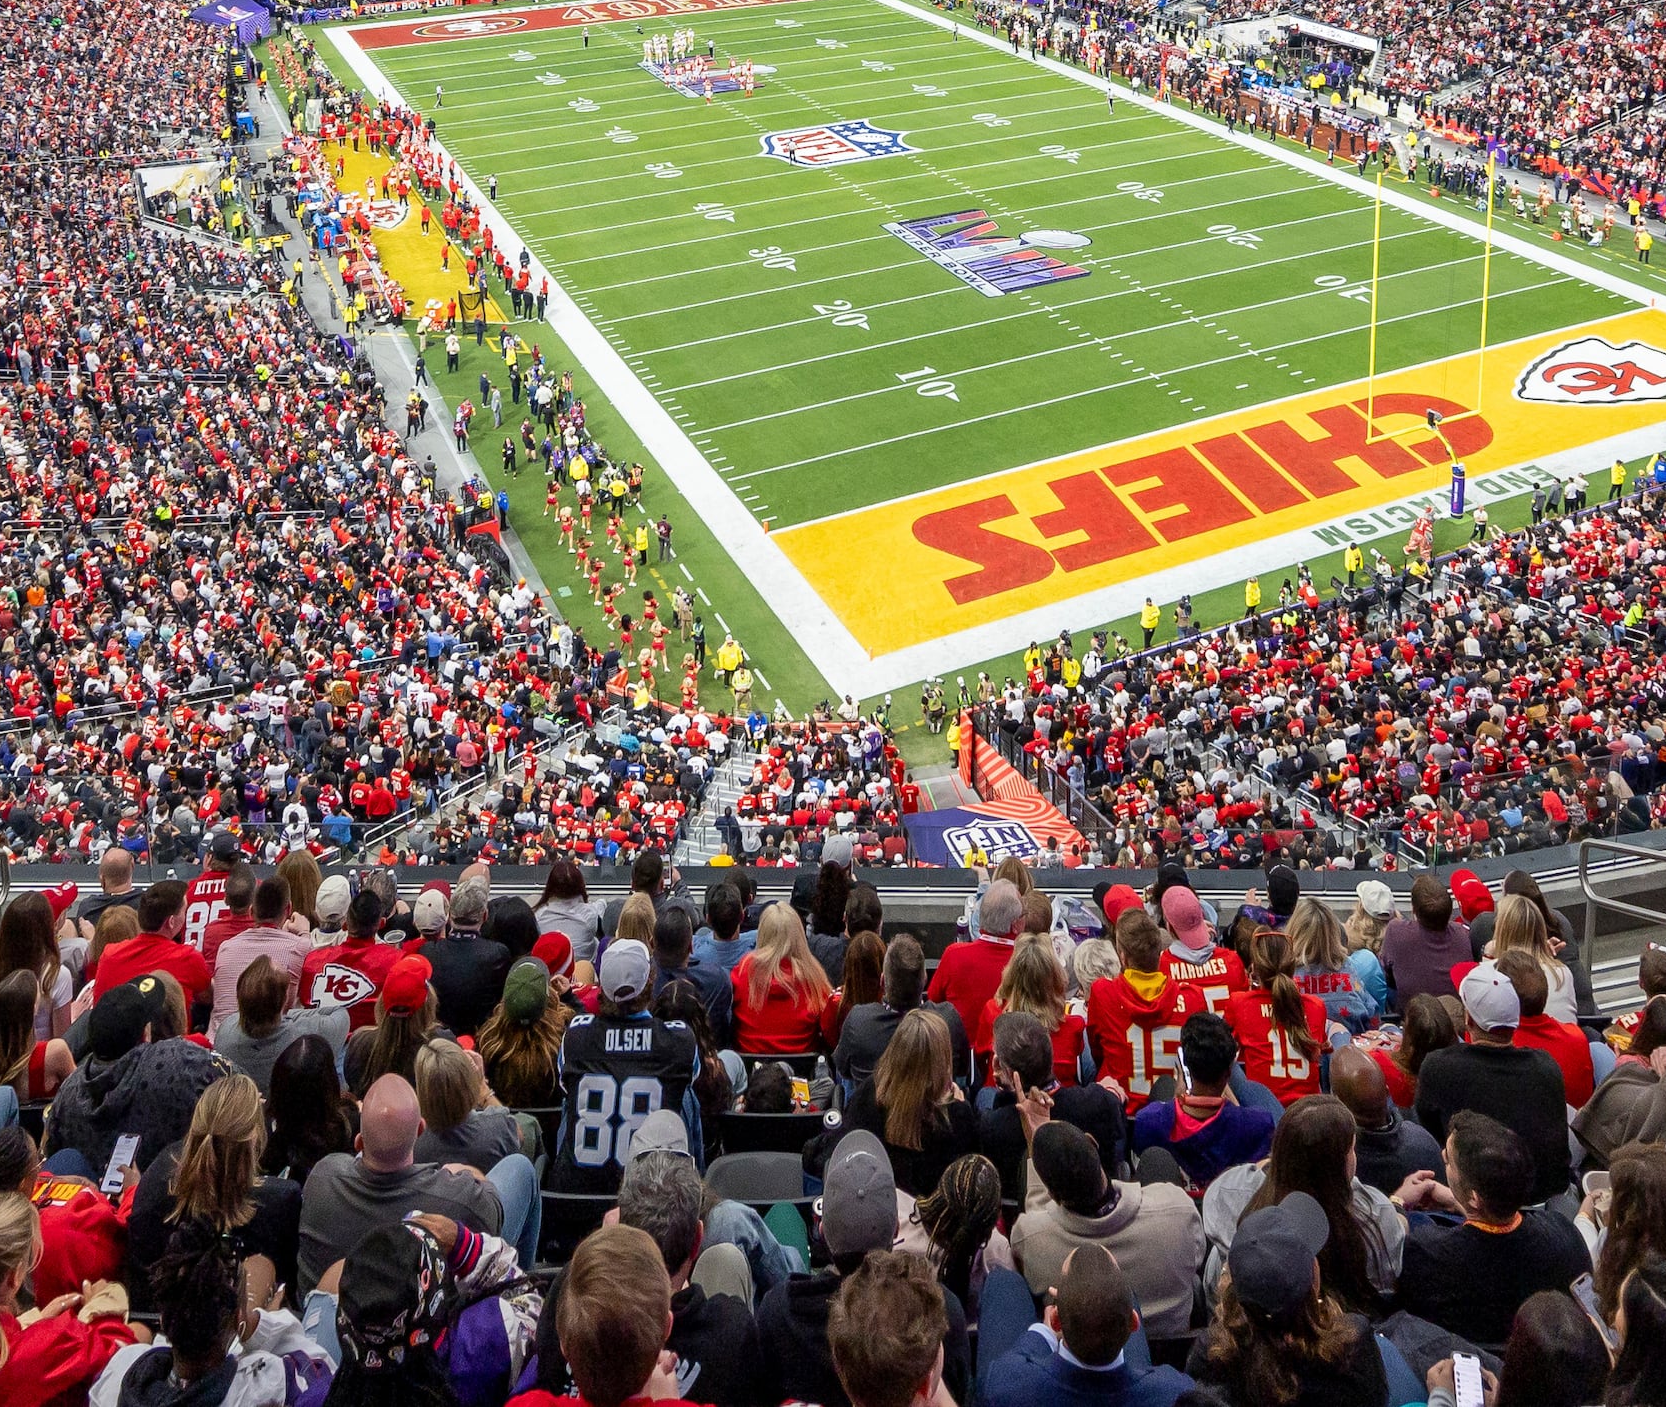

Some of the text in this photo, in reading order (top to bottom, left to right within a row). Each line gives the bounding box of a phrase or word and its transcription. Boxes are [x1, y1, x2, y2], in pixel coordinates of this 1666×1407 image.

[568, 97, 601, 112] 30
[605, 125, 639, 143] 40
[972, 112, 1014, 129] 50
[777, 130, 858, 163] NFL
[645, 162, 684, 179] 50
[693, 202, 735, 220] 40
[1206, 224, 1264, 249] 20
[749, 246, 796, 268] 30
[893, 228, 987, 291] SUPER BOWL
[813, 299, 869, 327] 20
[895, 366, 955, 397] 10
[1474, 464, 1558, 496] END
[912, 393, 1495, 605] CHIEFS
[1169, 958, 1227, 978] MAHOMES
[324, 974, 360, 1001] KC
[604, 1028, 652, 1052] OLSEN
[1125, 1022, 1183, 1097] 15
[1268, 1028, 1310, 1080] 15
[573, 1073, 663, 1167] 88
